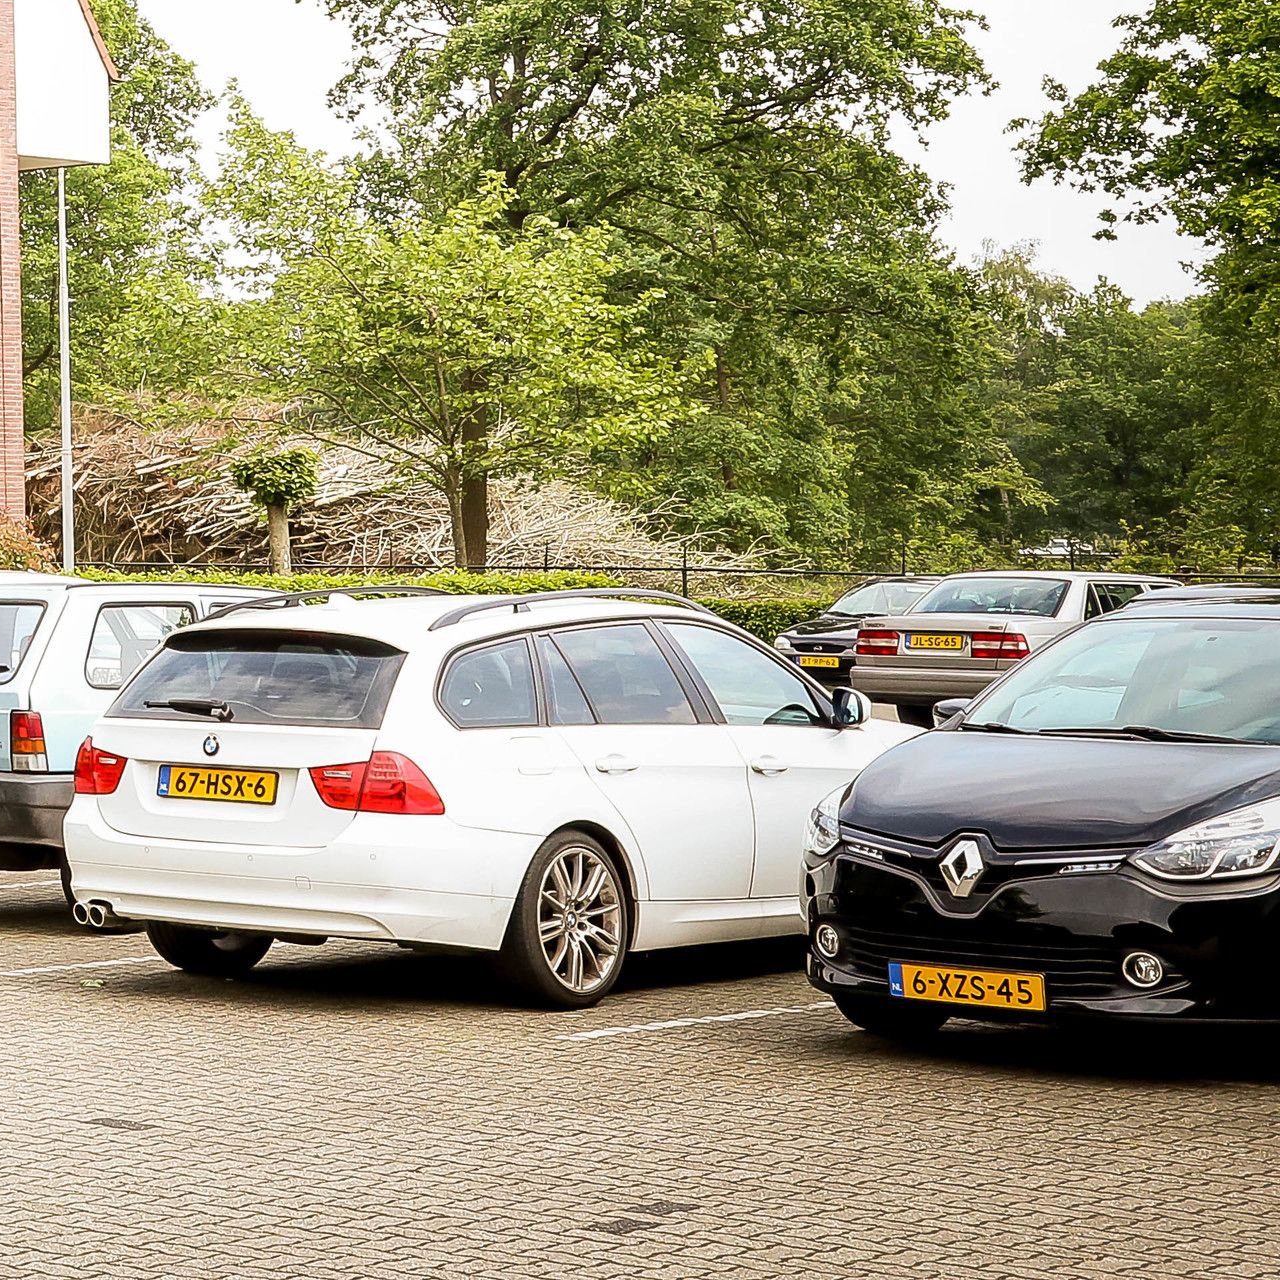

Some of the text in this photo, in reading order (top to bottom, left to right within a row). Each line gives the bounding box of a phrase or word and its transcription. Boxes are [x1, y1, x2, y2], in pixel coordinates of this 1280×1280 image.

[913, 637, 957, 646] JL-SG-65
[175, 771, 266, 798] 67-HSX-6
[912, 970, 1033, 1005] 6-XZS-45
